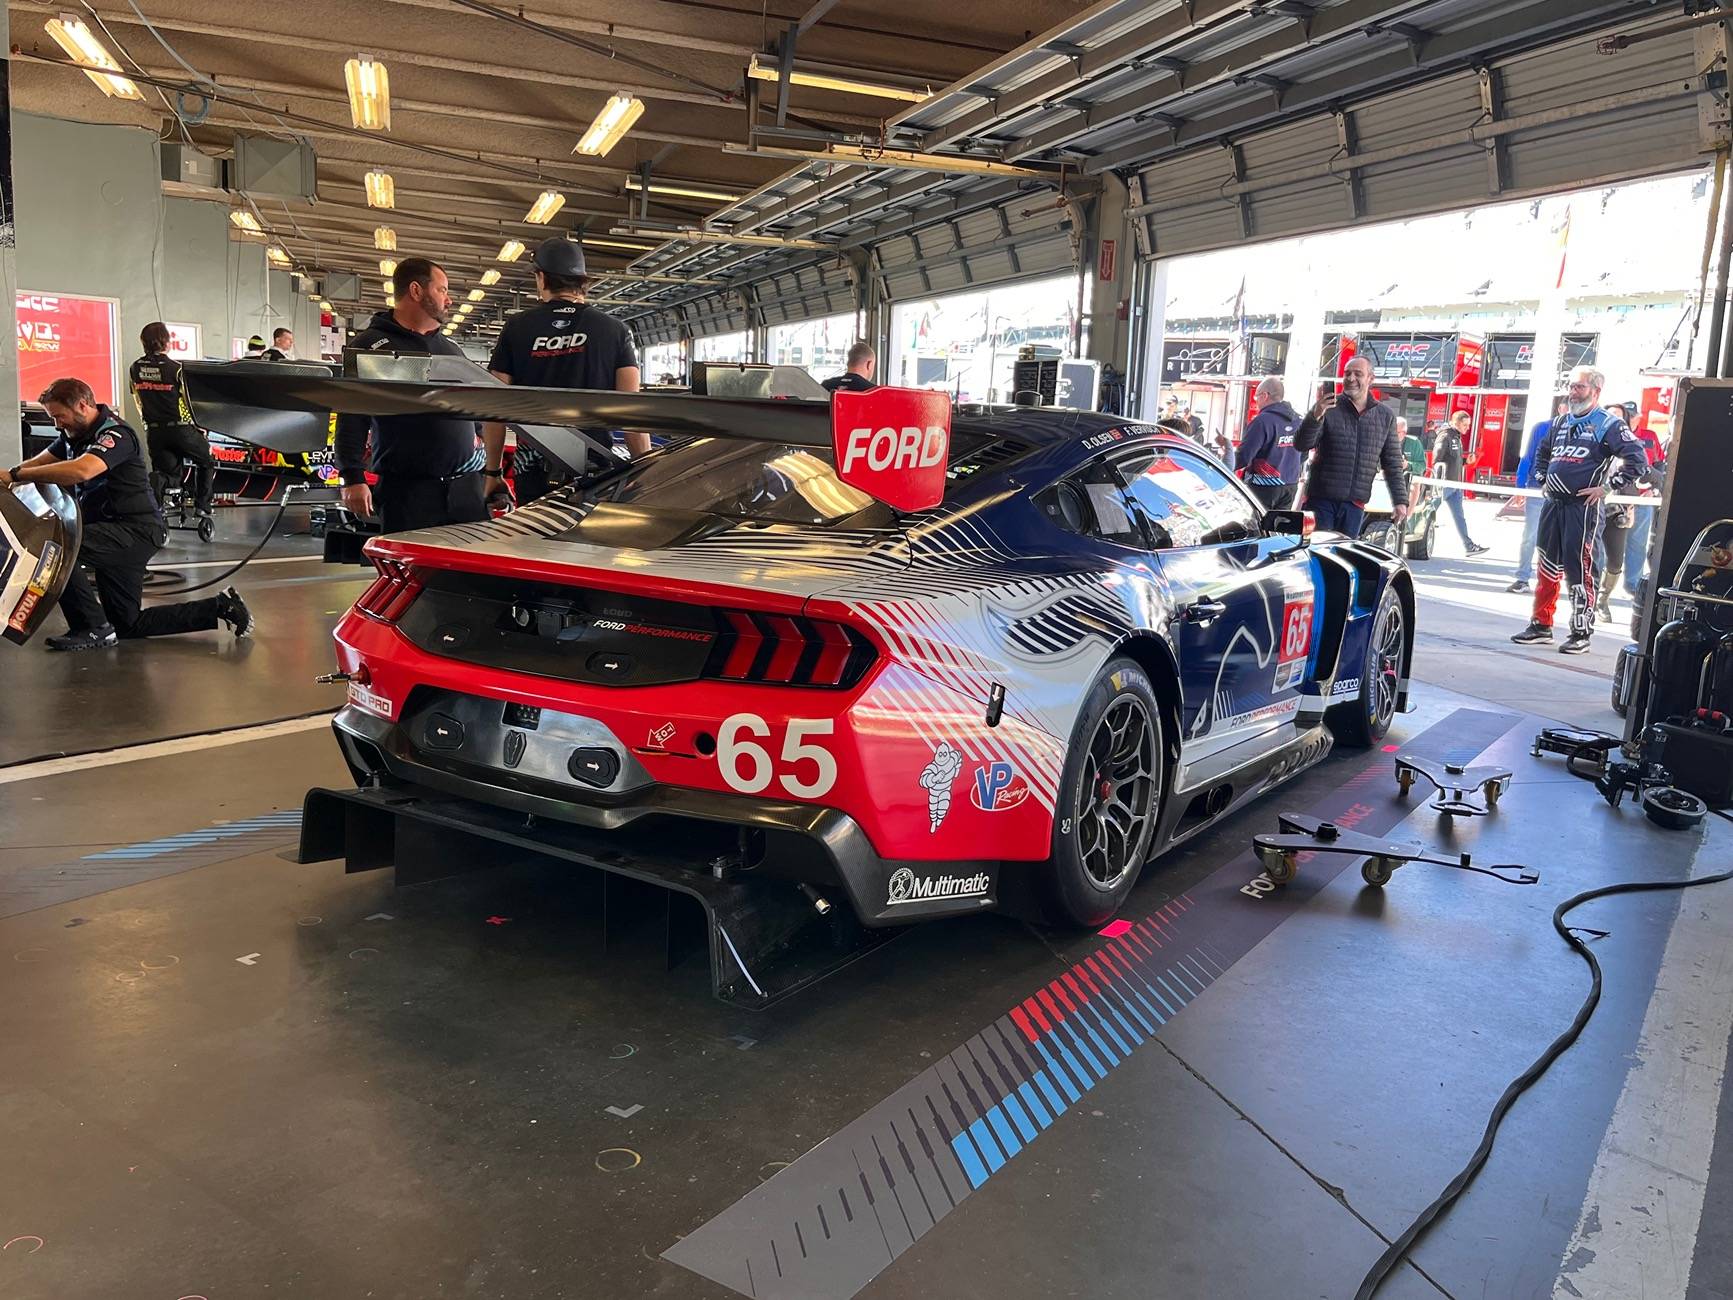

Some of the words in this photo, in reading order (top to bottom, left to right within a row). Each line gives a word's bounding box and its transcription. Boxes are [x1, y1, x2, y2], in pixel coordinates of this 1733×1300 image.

[532, 332, 588, 351] FORD
[1166, 361, 1223, 372] RILEY
[842, 426, 947, 474] FORD
[1089, 431, 1115, 447] OLSEN
[1286, 607, 1310, 657] 65
[1333, 677, 1359, 692] sparco
[368, 695, 390, 713] PRO
[717, 712, 838, 799] 65
[975, 761, 1013, 811] VP
[996, 786, 1029, 804] Racing
[912, 872, 991, 898] Multimatic
[1239, 871, 1276, 899] FO
